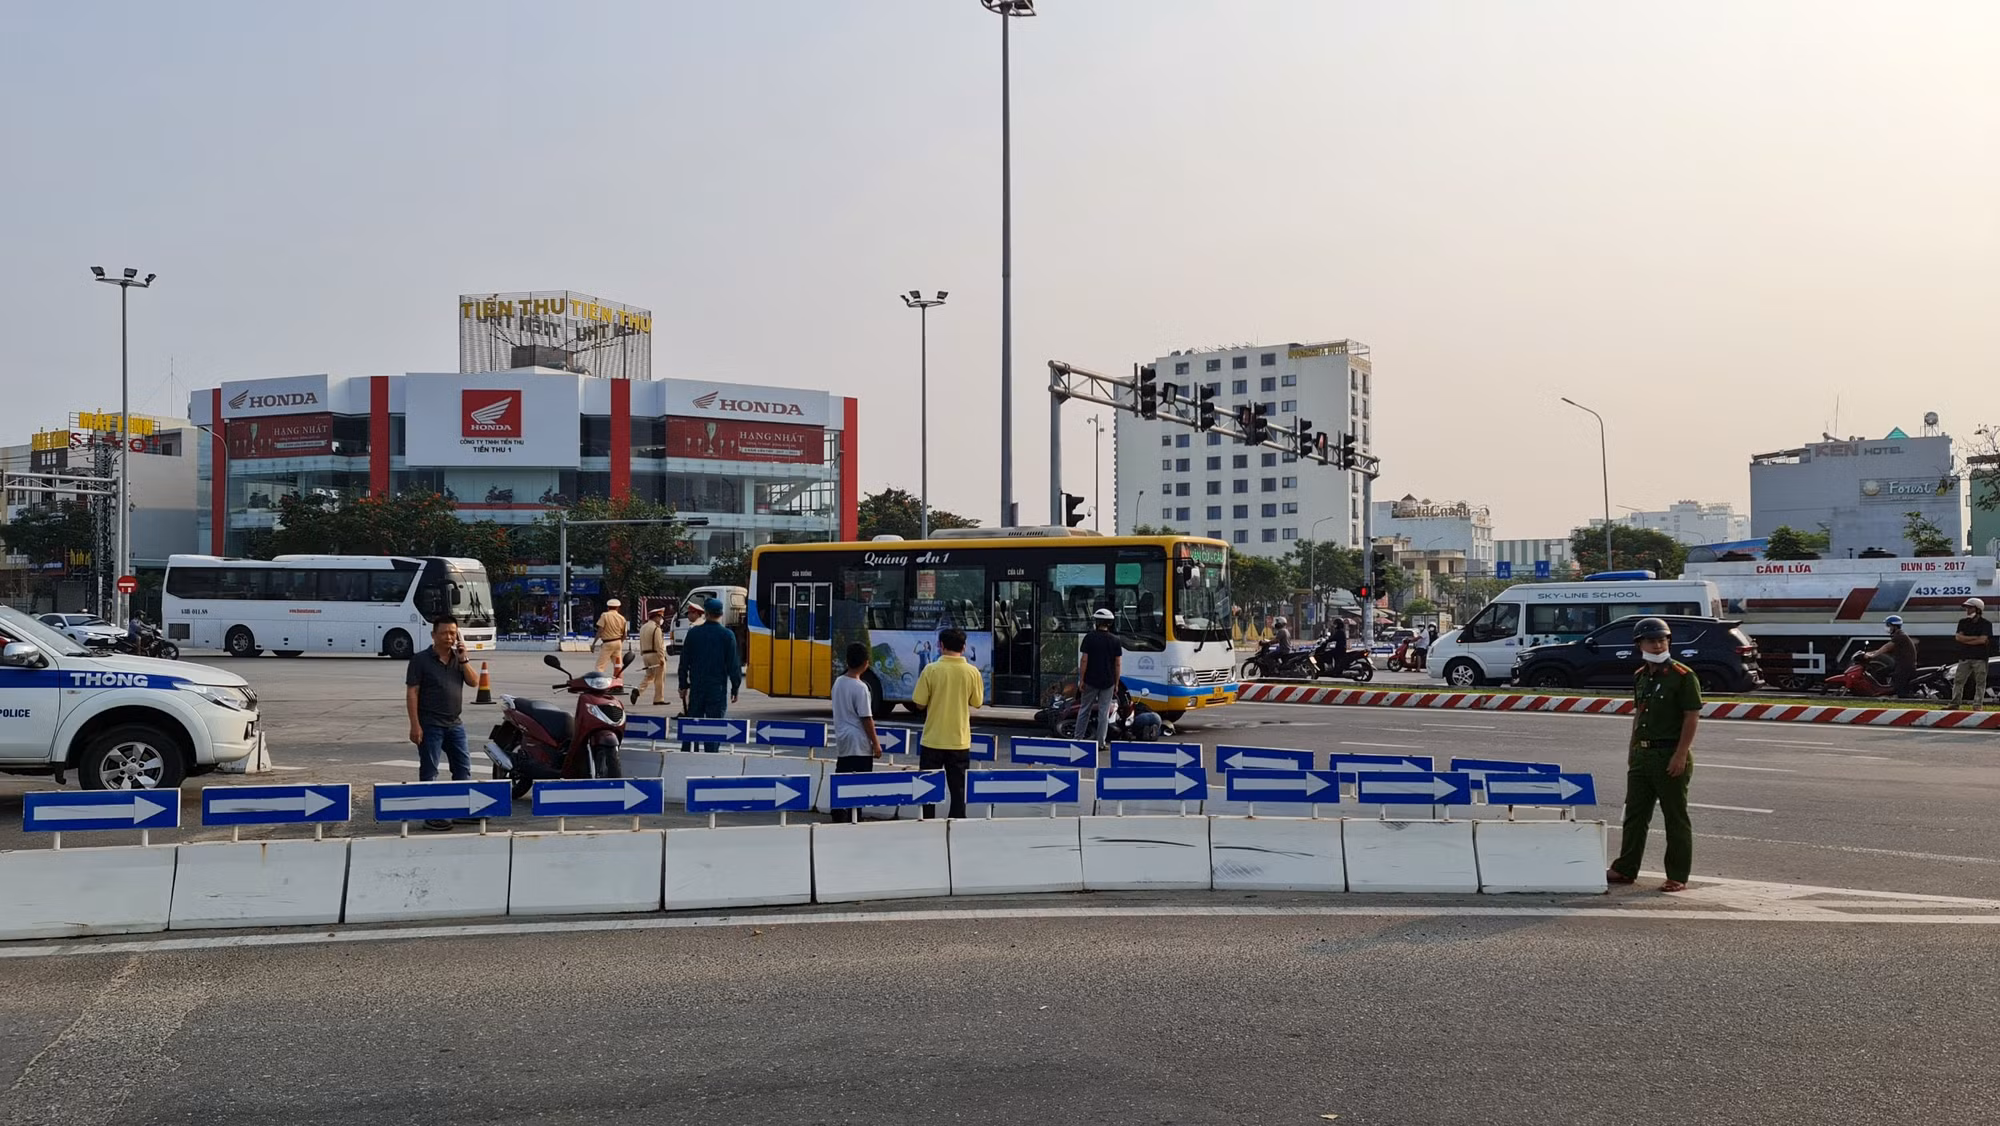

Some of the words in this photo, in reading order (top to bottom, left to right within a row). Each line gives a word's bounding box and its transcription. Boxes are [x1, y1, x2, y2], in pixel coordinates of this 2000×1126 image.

[518, 298, 565, 316] THU
[617, 309, 652, 333] THU
[249, 392, 319, 409] HONDA
[719, 398, 805, 416] HONDA
[274, 426, 300, 437] HẠNG
[302, 423, 329, 434] NHẤT
[739, 431, 772, 441] HẠNG
[774, 432, 805, 443] NHẤT
[1815, 444, 1859, 458] KEN
[1863, 446, 1905, 456] HOTEL
[1888, 481, 1932, 495] Forest
[1925, 562, 1936, 571] 05
[1944, 561, 1966, 571] 2017
[1537, 592, 1589, 600] SKY-LINE
[1592, 591, 1642, 599] SCHOOL
[1915, 586, 1972, 595] 43X-2352
[70, 671, 149, 687] THÔNG
